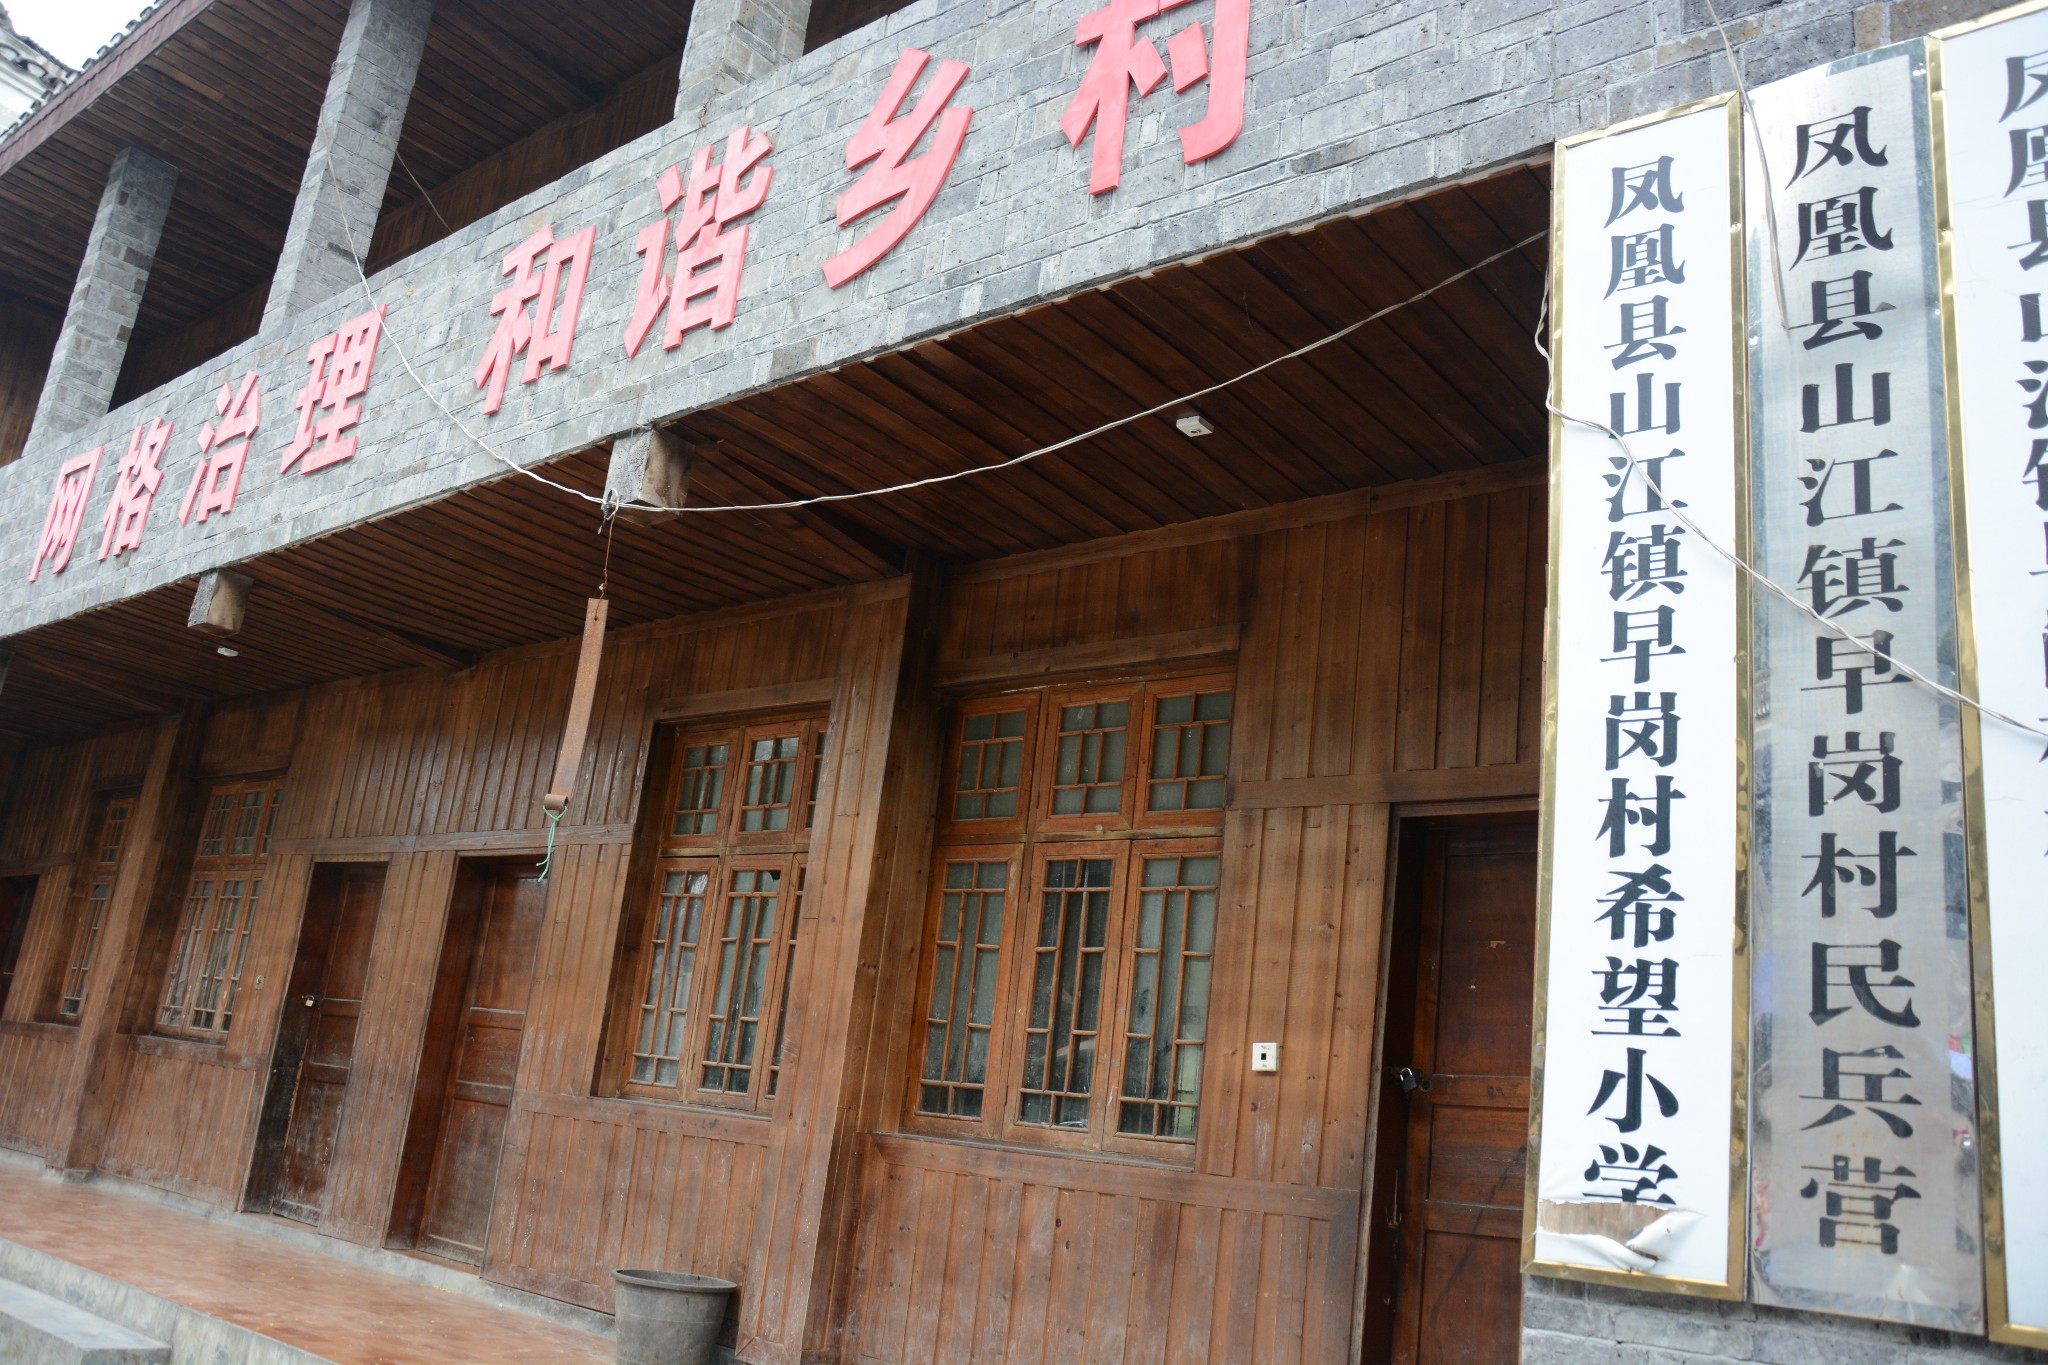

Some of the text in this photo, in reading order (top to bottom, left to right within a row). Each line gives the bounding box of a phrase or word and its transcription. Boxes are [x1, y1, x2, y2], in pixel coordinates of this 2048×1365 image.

[28, 303, 388, 583] 网格治理
[1582, 155, 1688, 1205] 凤凰县山江镇早岗村希望小学
[1786, 105, 1923, 1256] 凤凰县山江镇早岗村民兵营
